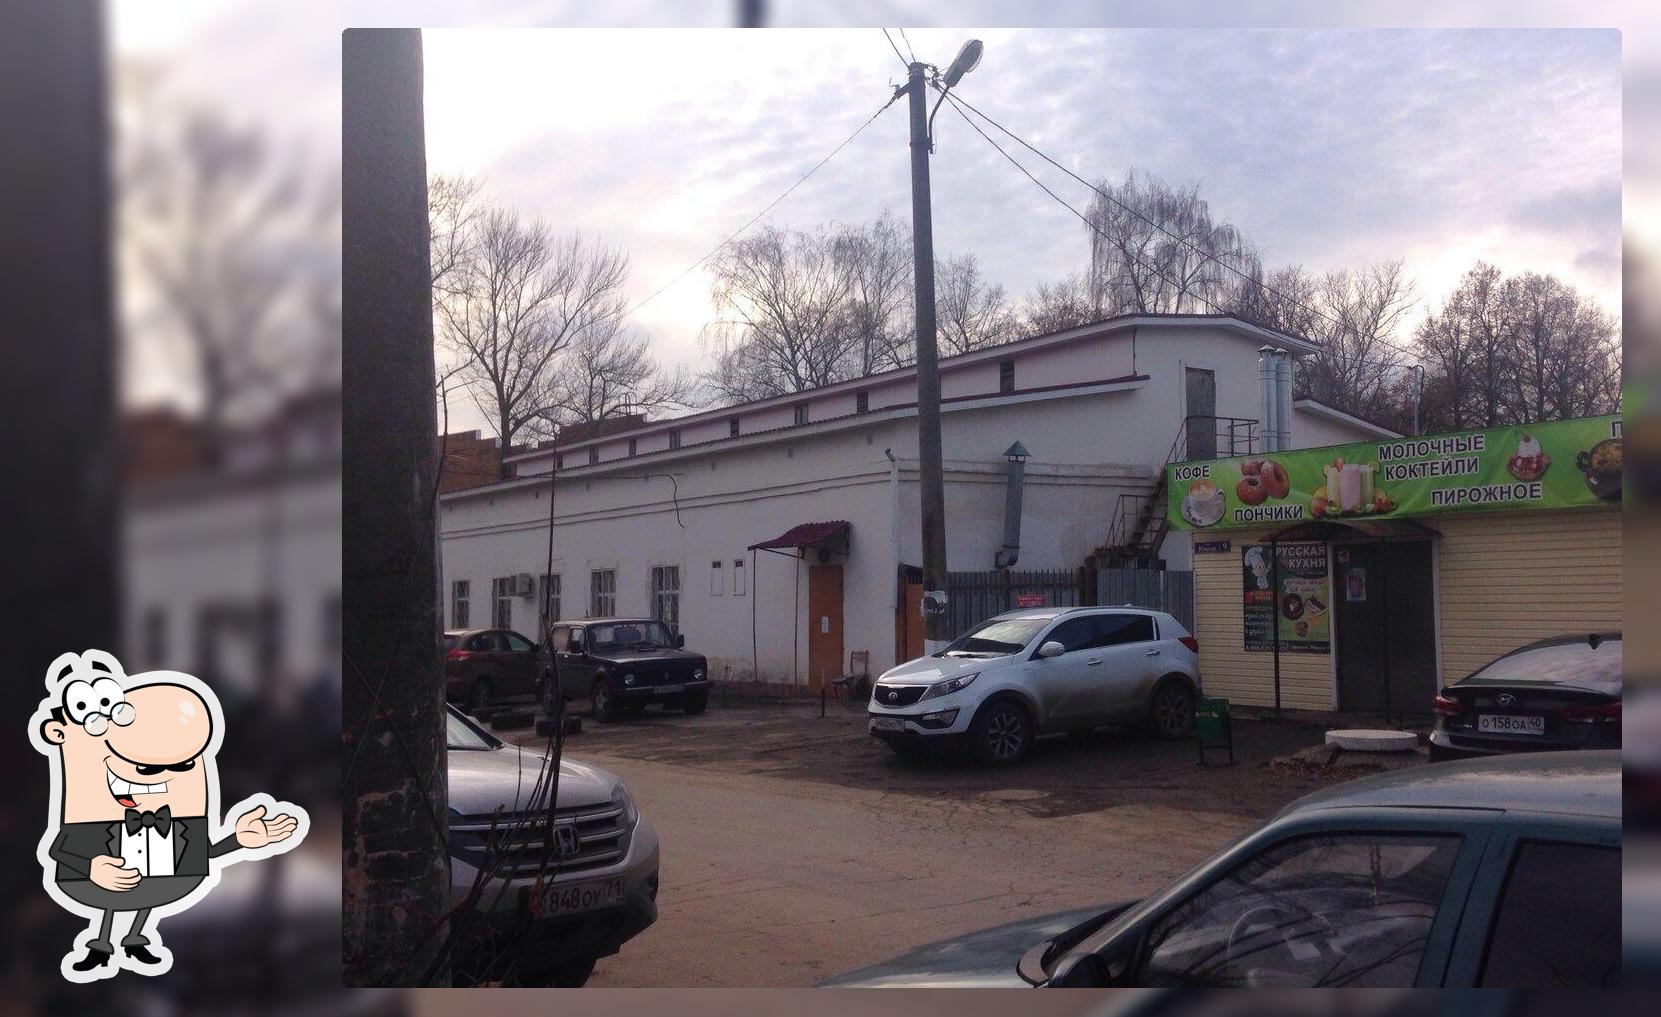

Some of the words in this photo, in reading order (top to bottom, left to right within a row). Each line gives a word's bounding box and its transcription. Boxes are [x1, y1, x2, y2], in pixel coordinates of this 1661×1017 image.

[1378, 435, 1485, 461] МОЛОЧНЫЕ
[1174, 465, 1210, 480] КОФЕ
[1385, 457, 1479, 481] КОКТЕЙЛИ
[1431, 482, 1542, 506] ПИРОЖНОЕ
[1234, 504, 1303, 521] ПОНЧИКИ
[1275, 546, 1326, 557] РУССКАЯ
[1288, 558, 1326, 569] КУХНЯ
